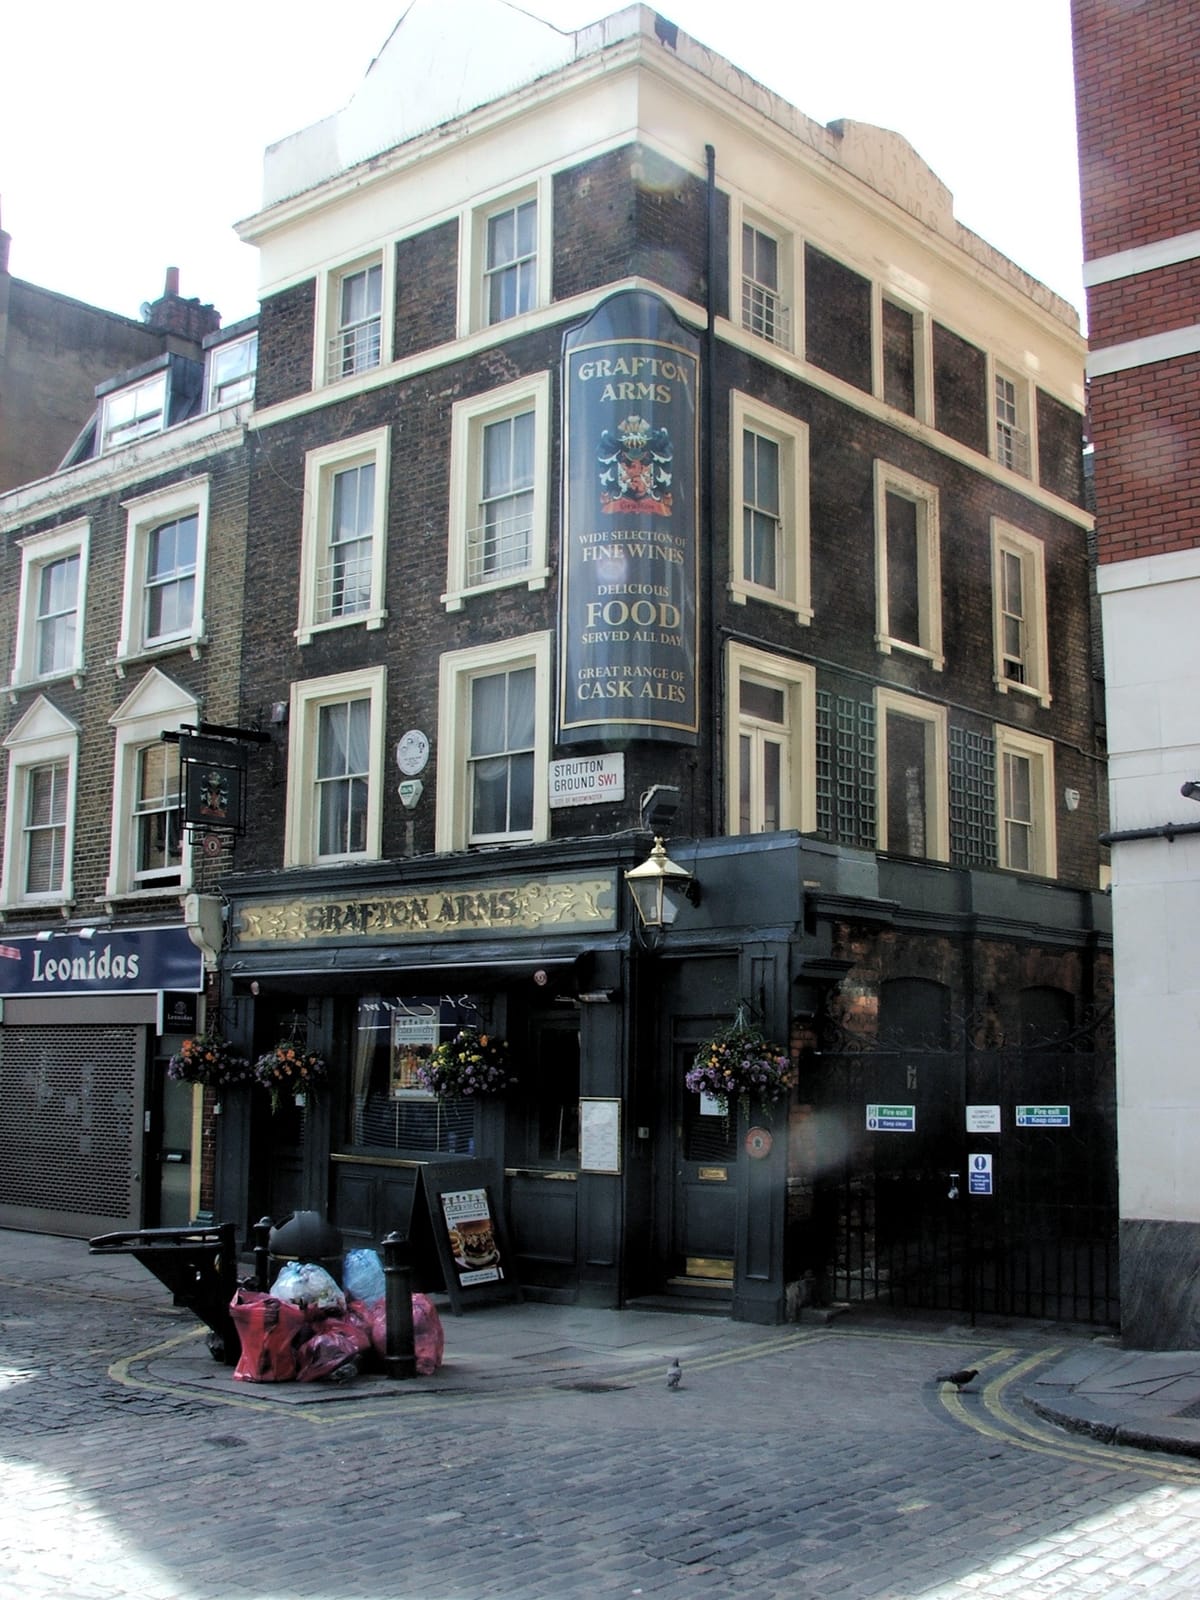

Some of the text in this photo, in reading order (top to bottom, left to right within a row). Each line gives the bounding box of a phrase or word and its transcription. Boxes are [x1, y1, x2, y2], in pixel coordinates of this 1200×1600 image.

[578, 357, 688, 385] GRAFTON
[600, 382, 671, 404] ARMS
[578, 530, 687, 547] WIDE SELECTION OF
[582, 544, 685, 564] FINE WINES
[597, 584, 669, 596] DELICIOUS
[586, 600, 681, 628] FOOD
[581, 631, 683, 646] SERVED ALL DAY
[578, 667, 686, 681] GREAT RANGE OF
[577, 681, 686, 704] CASK ALES
[554, 760, 603, 777] STRUTTON
[554, 774, 617, 792] GROUND SW1
[305, 891, 518, 932] GRAFTON ARMS
[32, 944, 140, 982] Leonidas
